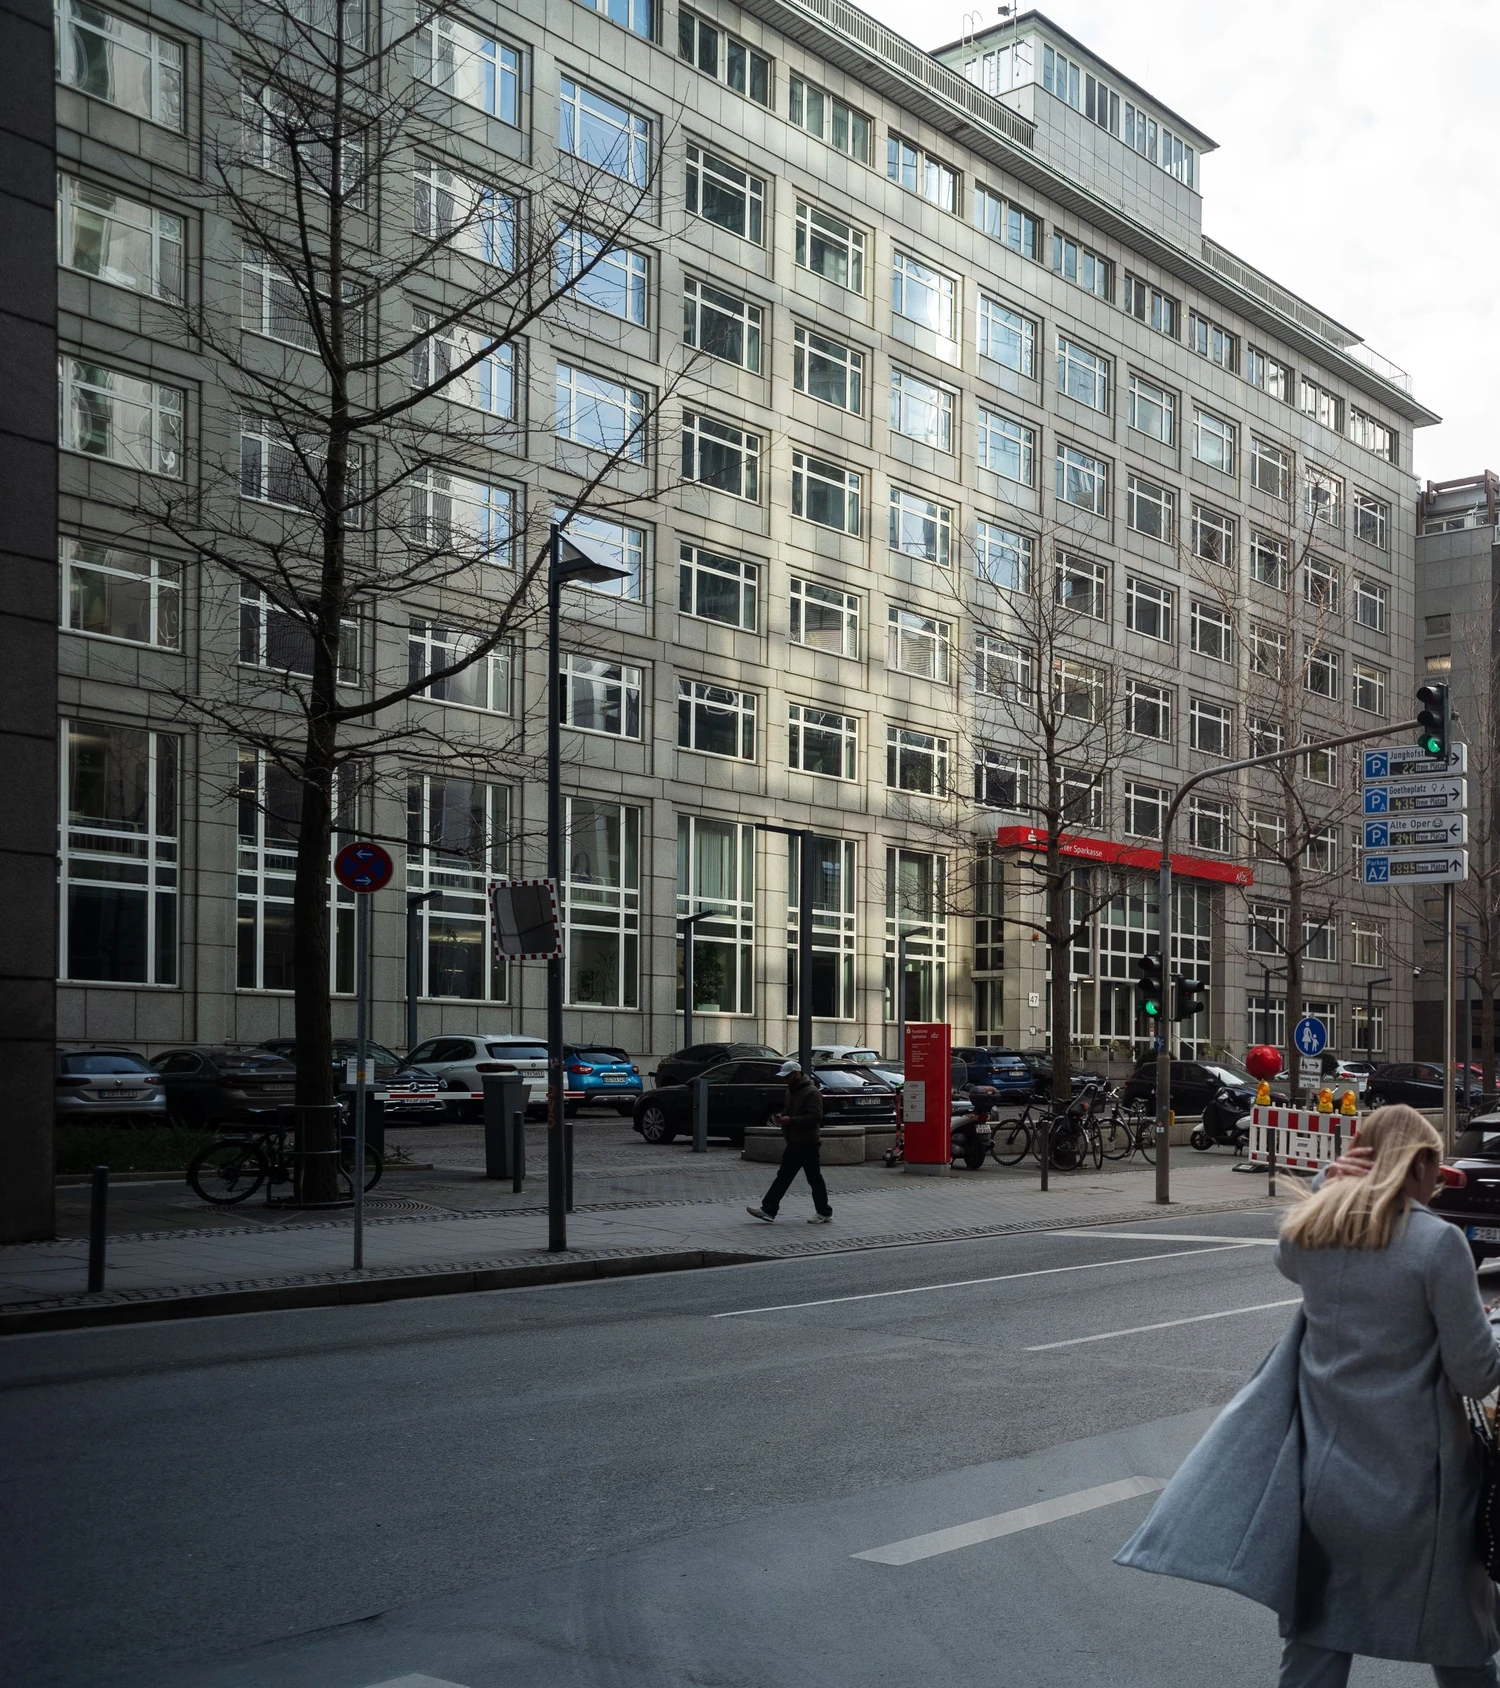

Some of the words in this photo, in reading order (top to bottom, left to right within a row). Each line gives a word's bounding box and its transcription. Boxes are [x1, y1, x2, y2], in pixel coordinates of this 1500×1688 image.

[1389, 750, 1425, 760] Junghofst
[1402, 763, 1415, 775] 22
[1416, 763, 1428, 771] freie
[1389, 785, 1427, 795] Goetheplatz
[1395, 797, 1415, 810] 435
[1416, 798, 1428, 806] freie
[1389, 821, 1407, 830] Alte
[1410, 820, 1431, 830] Oper
[1416, 833, 1428, 841] freie
[1430, 831, 1446, 840] Plätze
[1073, 845, 1103, 858] Sparkasse
[1417, 864, 1428, 872] freie
[1430, 863, 1446, 871] Plätze
[1368, 866, 1387, 880] AZ
